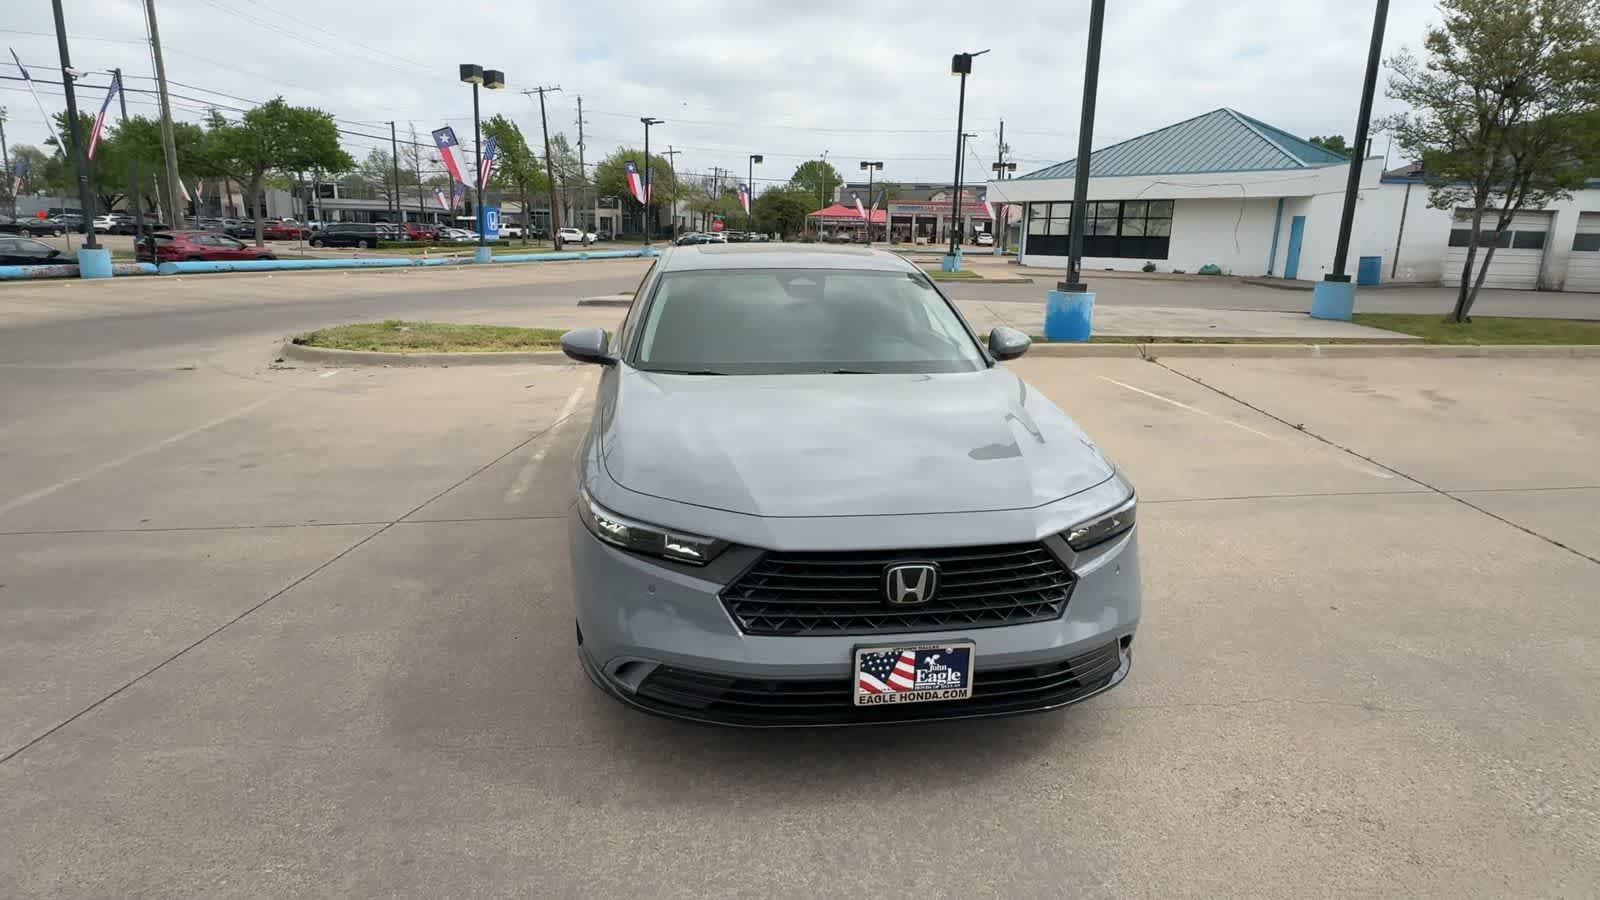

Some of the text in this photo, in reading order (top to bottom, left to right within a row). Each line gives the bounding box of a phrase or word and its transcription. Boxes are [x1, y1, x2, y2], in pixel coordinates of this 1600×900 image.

[928, 663, 947, 672] John
[916, 668, 961, 685] Eagle
[859, 689, 968, 705] EAGLE HONDA.COM
